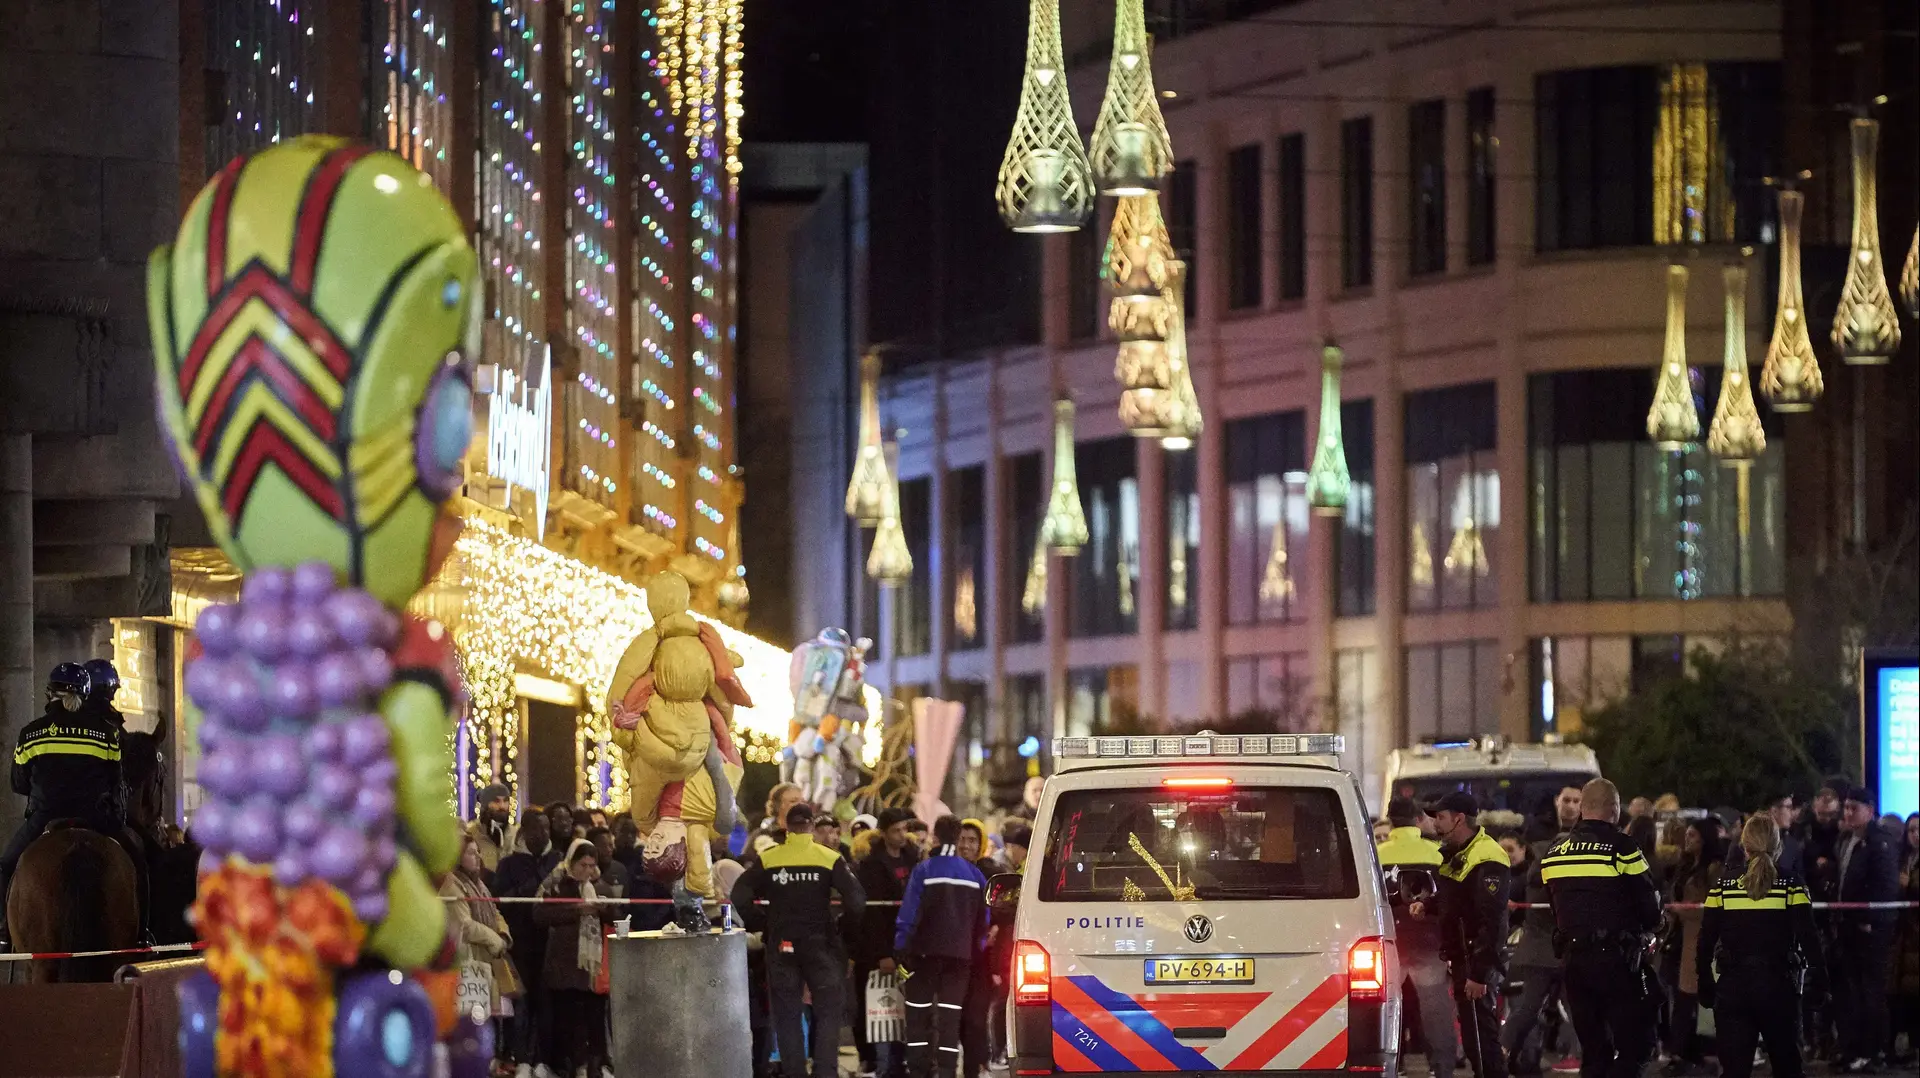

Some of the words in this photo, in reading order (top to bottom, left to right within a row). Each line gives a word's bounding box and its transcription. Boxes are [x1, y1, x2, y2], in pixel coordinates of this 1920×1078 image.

[42, 724, 89, 736] POLITIE
[1554, 840, 1601, 854] POLITIE
[772, 869, 820, 884] POLITIE
[1066, 917, 1144, 929] POLITIE
[460, 965, 486, 979] EW
[1160, 962, 1246, 978] PV-694-H
[455, 982, 489, 997] ORK
[1074, 1027, 1099, 1051] 7211
